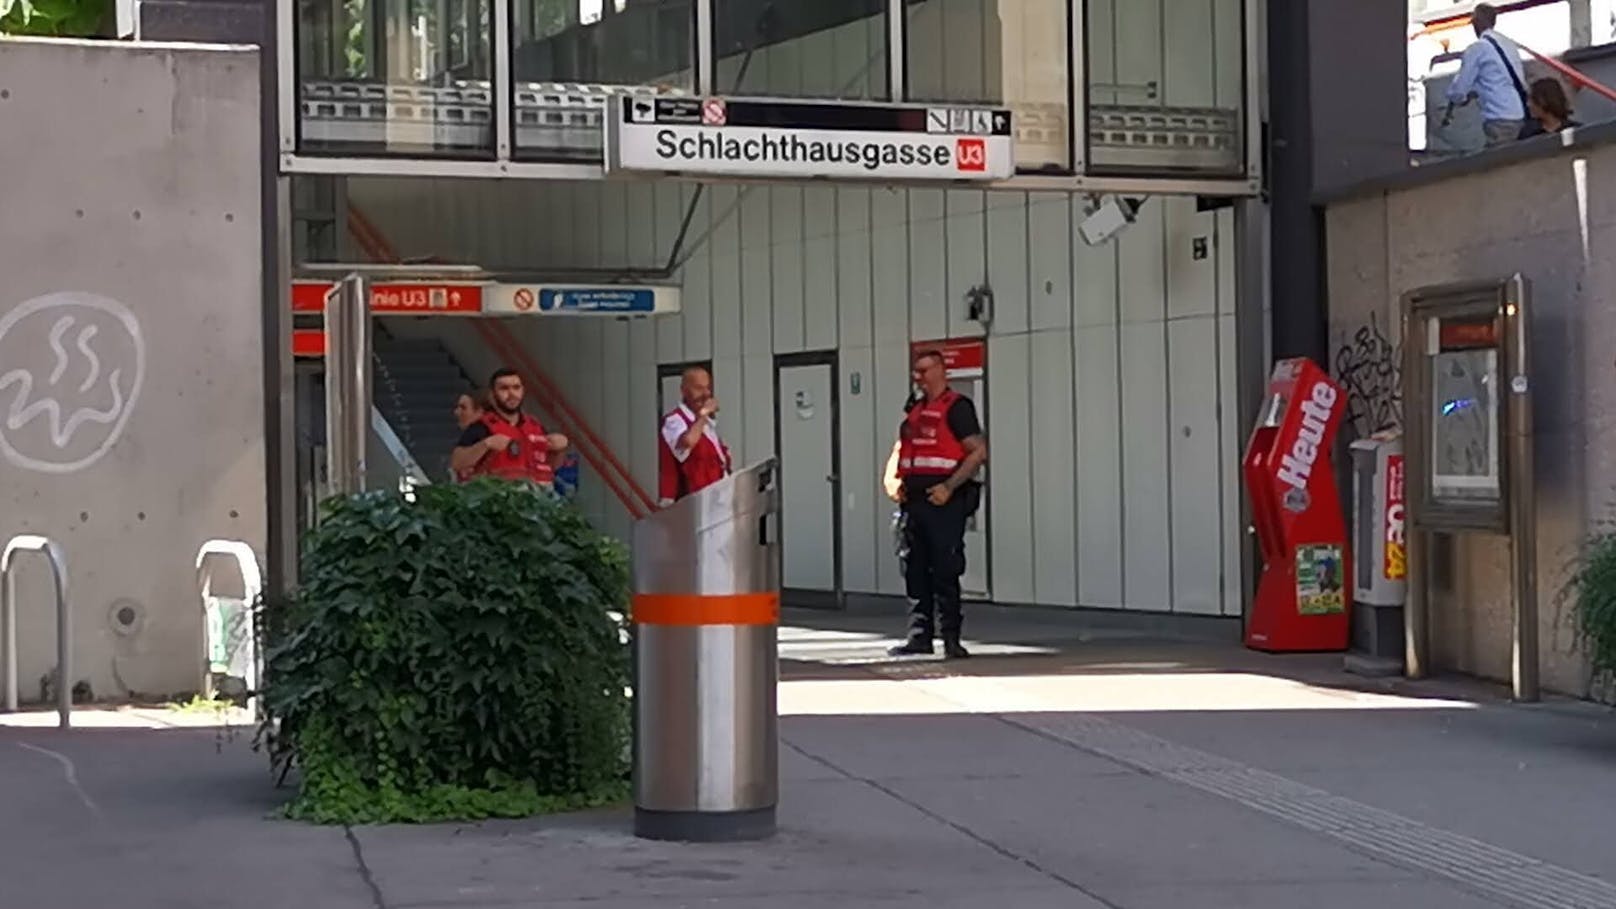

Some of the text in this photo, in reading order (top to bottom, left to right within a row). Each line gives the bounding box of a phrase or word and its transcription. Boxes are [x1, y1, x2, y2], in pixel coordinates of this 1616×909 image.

[656, 129, 984, 170] Schlachthausgasse U3
[369, 289, 427, 306] inie U3
[1276, 382, 1337, 490] Heute
